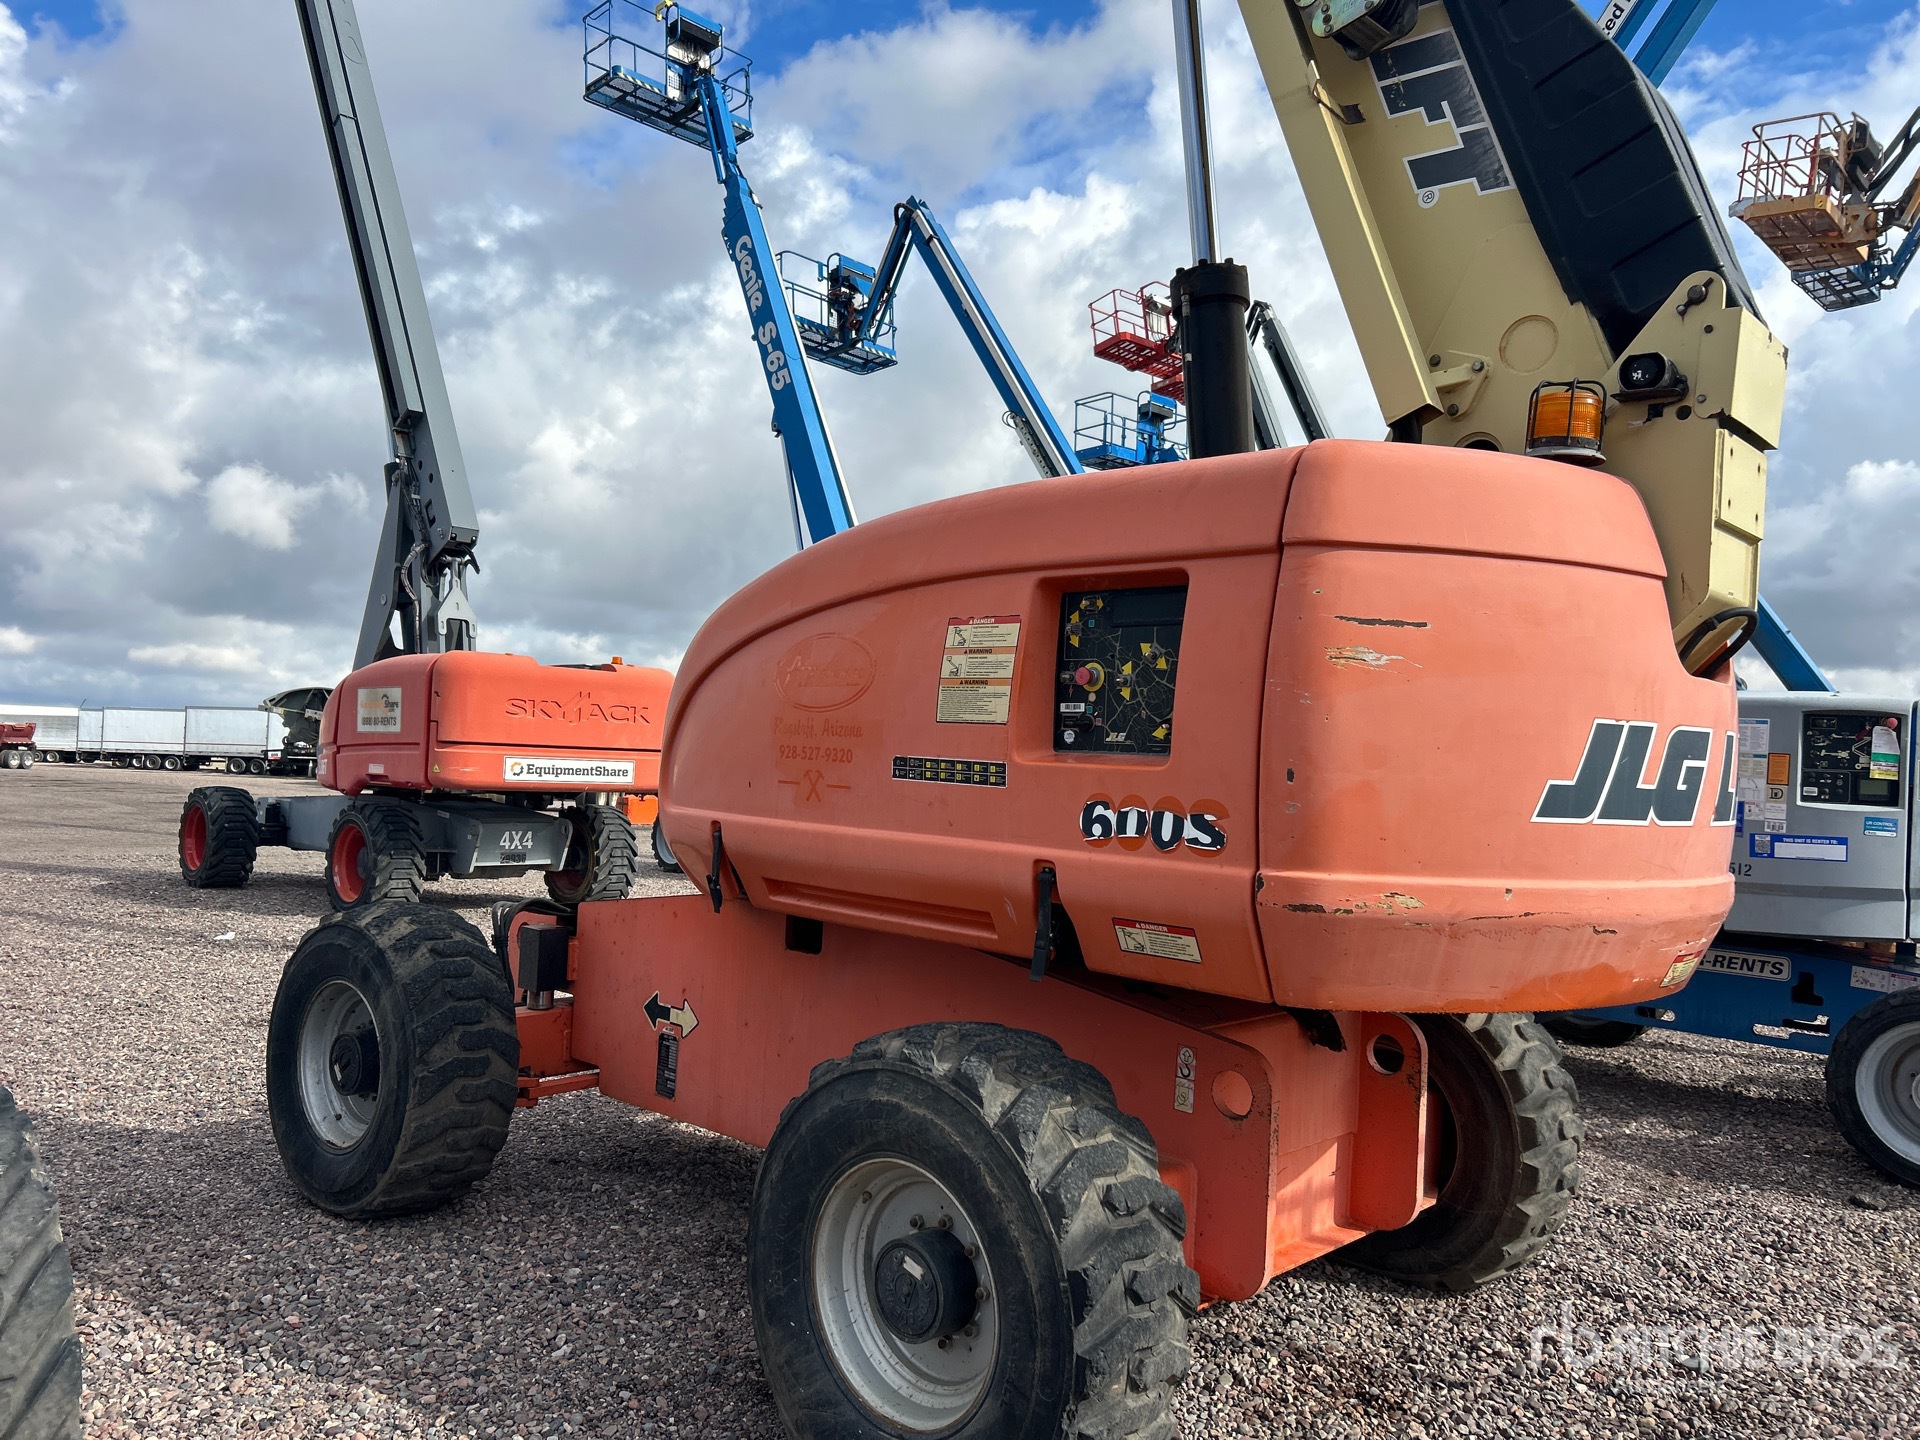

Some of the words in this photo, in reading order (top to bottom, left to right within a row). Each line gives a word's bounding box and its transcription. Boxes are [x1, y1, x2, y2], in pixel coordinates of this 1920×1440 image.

[735, 235, 763, 313] Genie
[757, 321, 791, 391] S-65
[504, 691, 650, 725] SKYJACK
[779, 744, 854, 764] 928-527-9320
[526, 764, 629, 778] EquipmentShare
[1530, 717, 1714, 827] JLG
[499, 830, 534, 850] 4X4
[1140, 923, 1168, 932] DANGER
